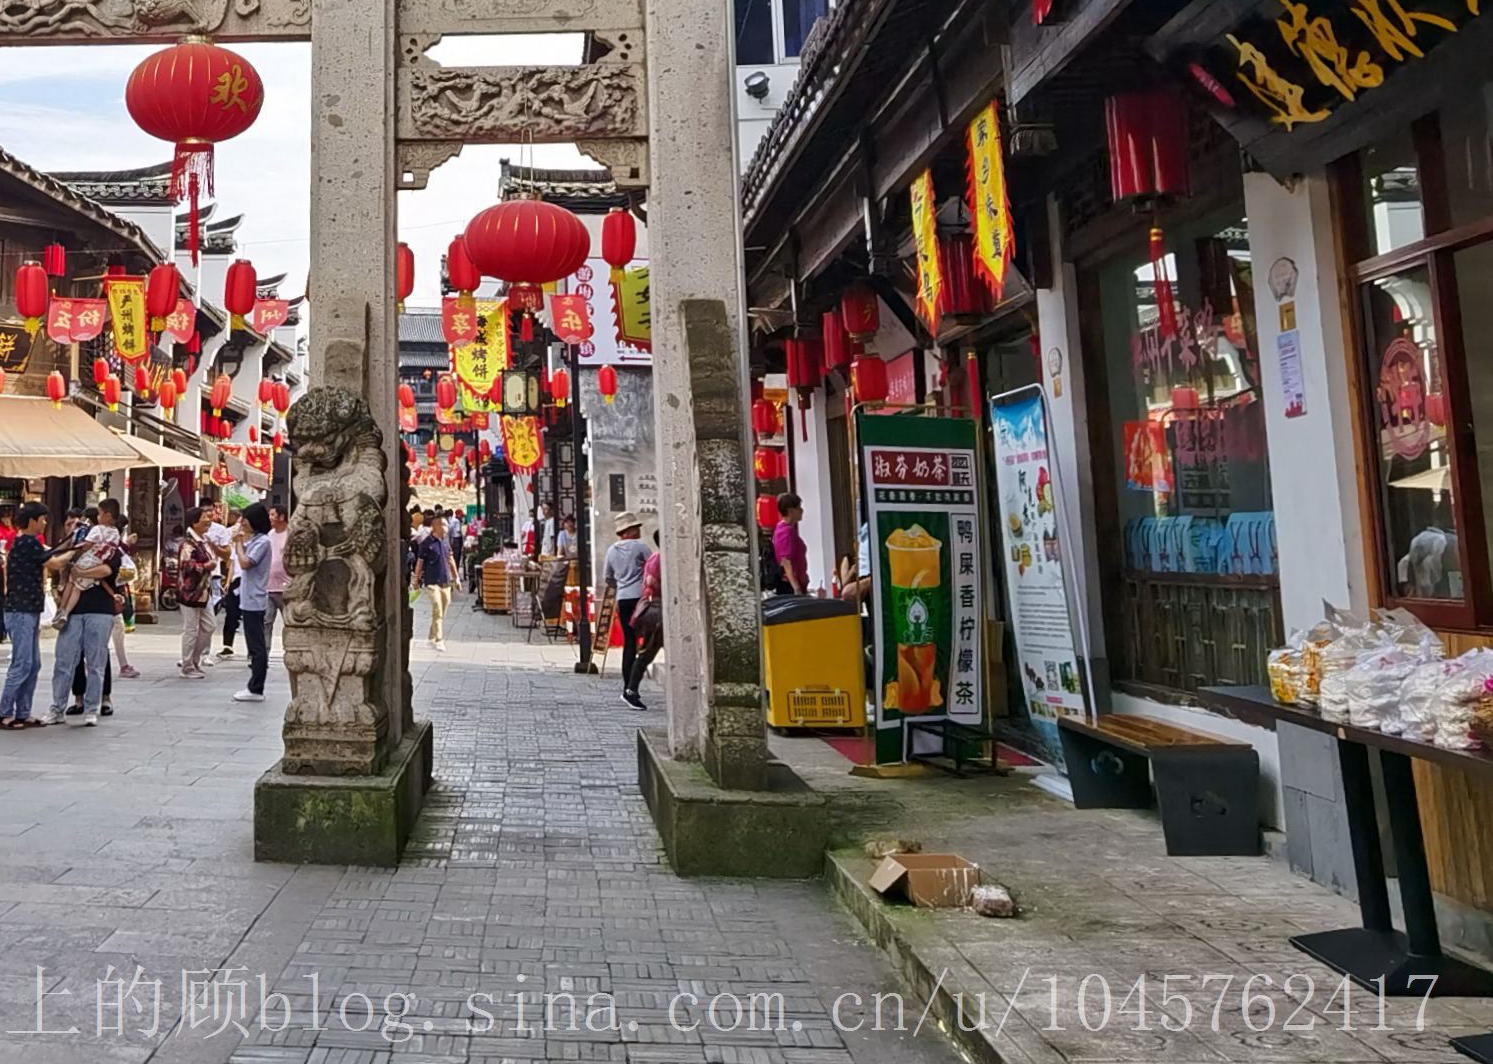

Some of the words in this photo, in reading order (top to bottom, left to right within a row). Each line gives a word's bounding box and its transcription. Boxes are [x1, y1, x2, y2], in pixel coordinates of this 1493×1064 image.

[874, 453, 947, 482] 淑芬奶茶
[955, 519, 976, 706] 鸭屎香柠檬茶
